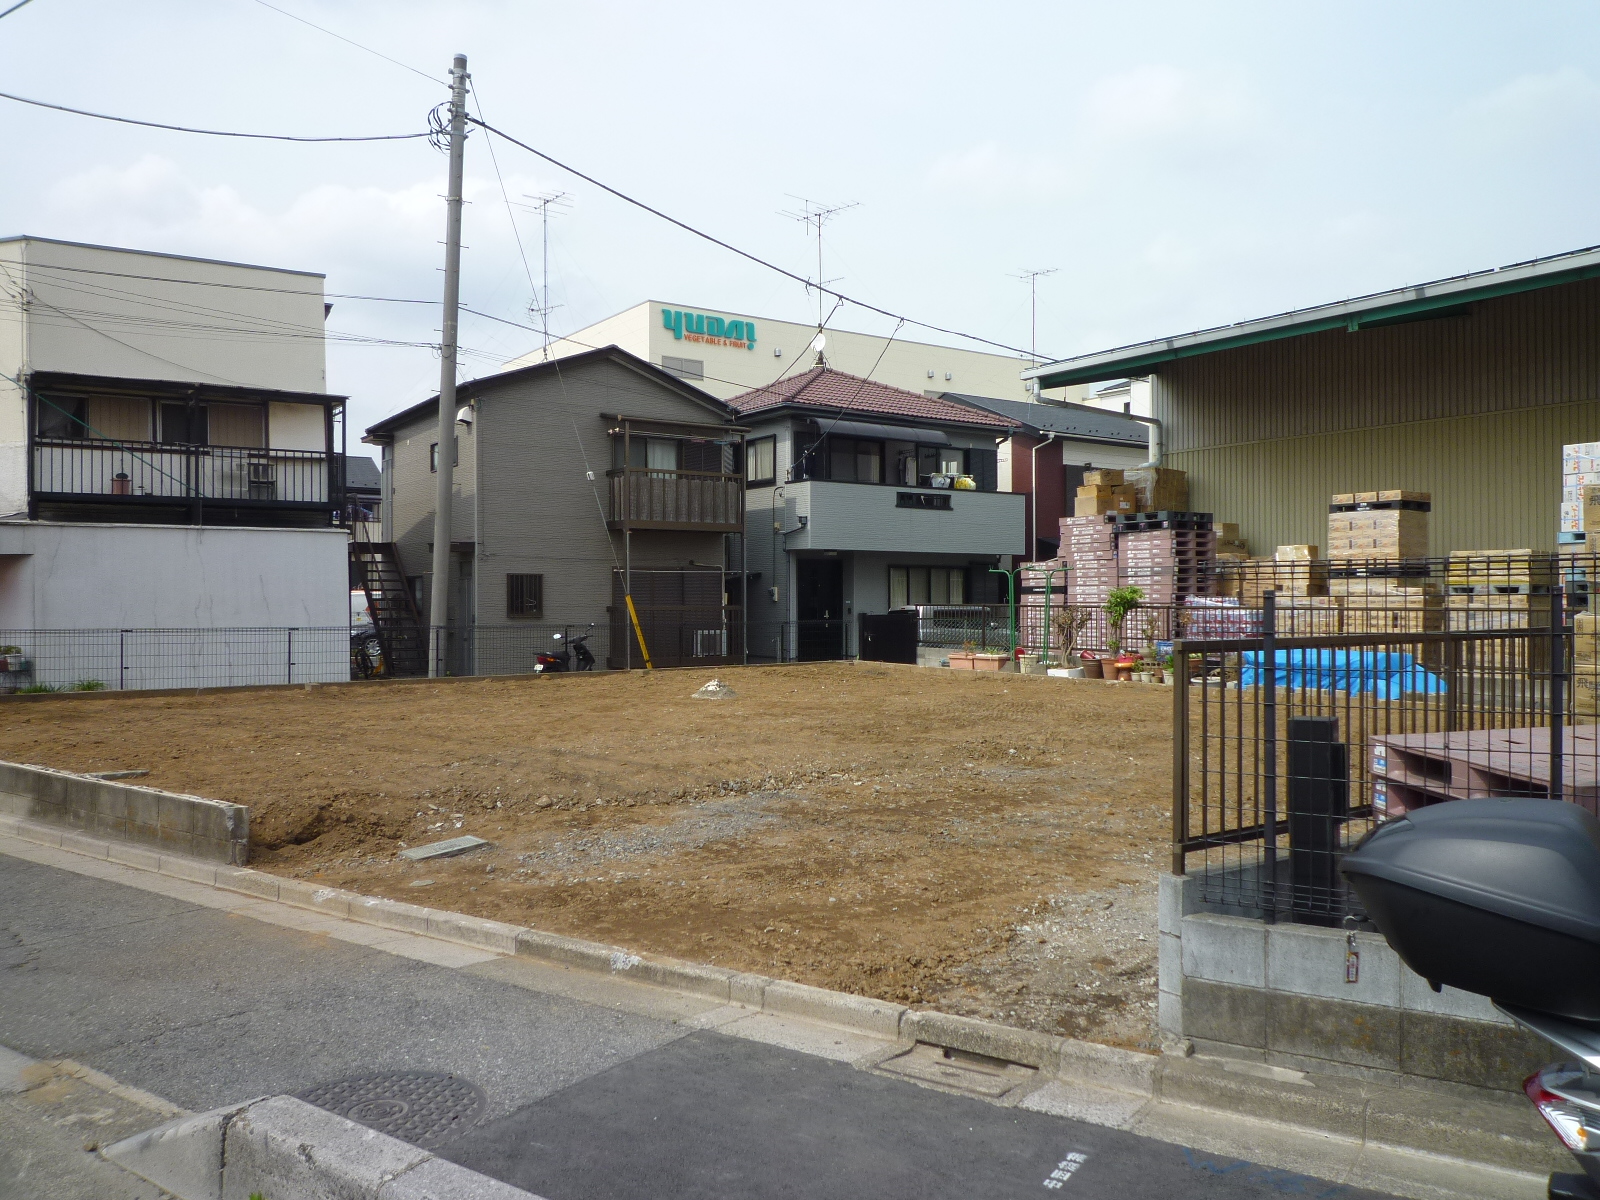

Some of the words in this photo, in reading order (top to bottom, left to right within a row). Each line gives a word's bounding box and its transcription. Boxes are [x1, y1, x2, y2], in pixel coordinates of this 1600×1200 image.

[684, 334, 722, 346] VEGETABLE
[722, 339, 728, 347] &
[729, 340, 747, 349] FRUIT
